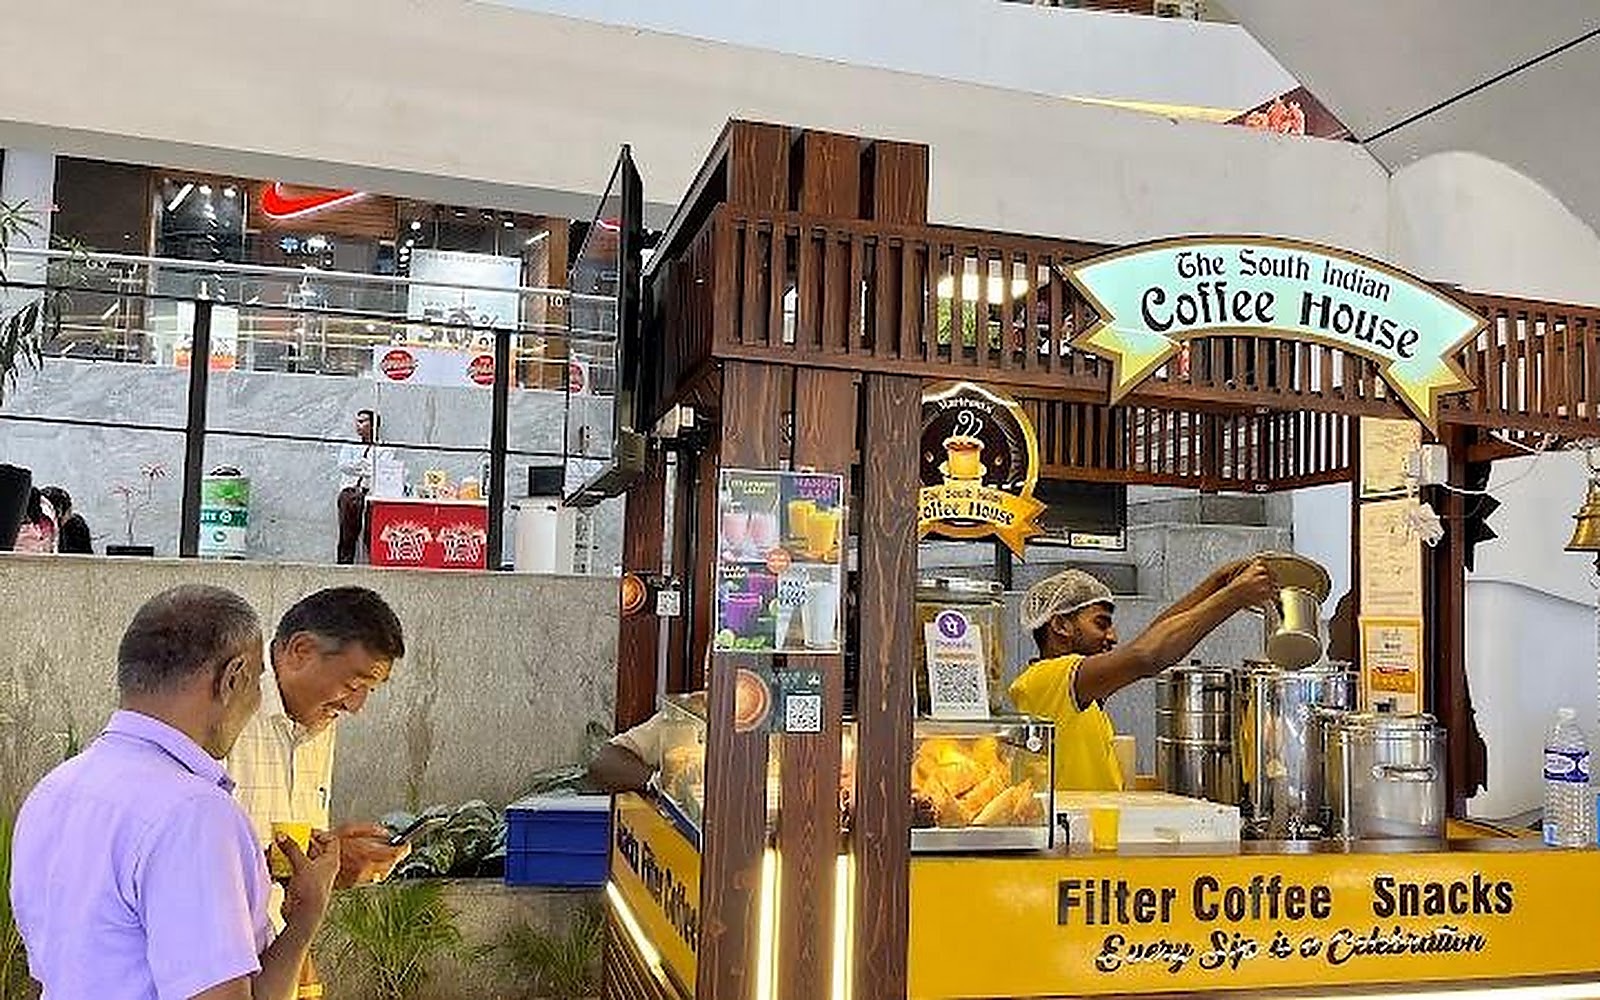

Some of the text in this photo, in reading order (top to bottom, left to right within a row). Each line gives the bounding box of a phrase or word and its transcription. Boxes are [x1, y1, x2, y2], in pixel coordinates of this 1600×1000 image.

[1177, 249, 1391, 301] The South Indian
[1141, 282, 1419, 359] Coffee House
[969, 501, 1015, 525] House
[1058, 874, 1514, 925] Filter Coffee Snacks
[1096, 925, 1487, 973] Every Sip is a Celebration
